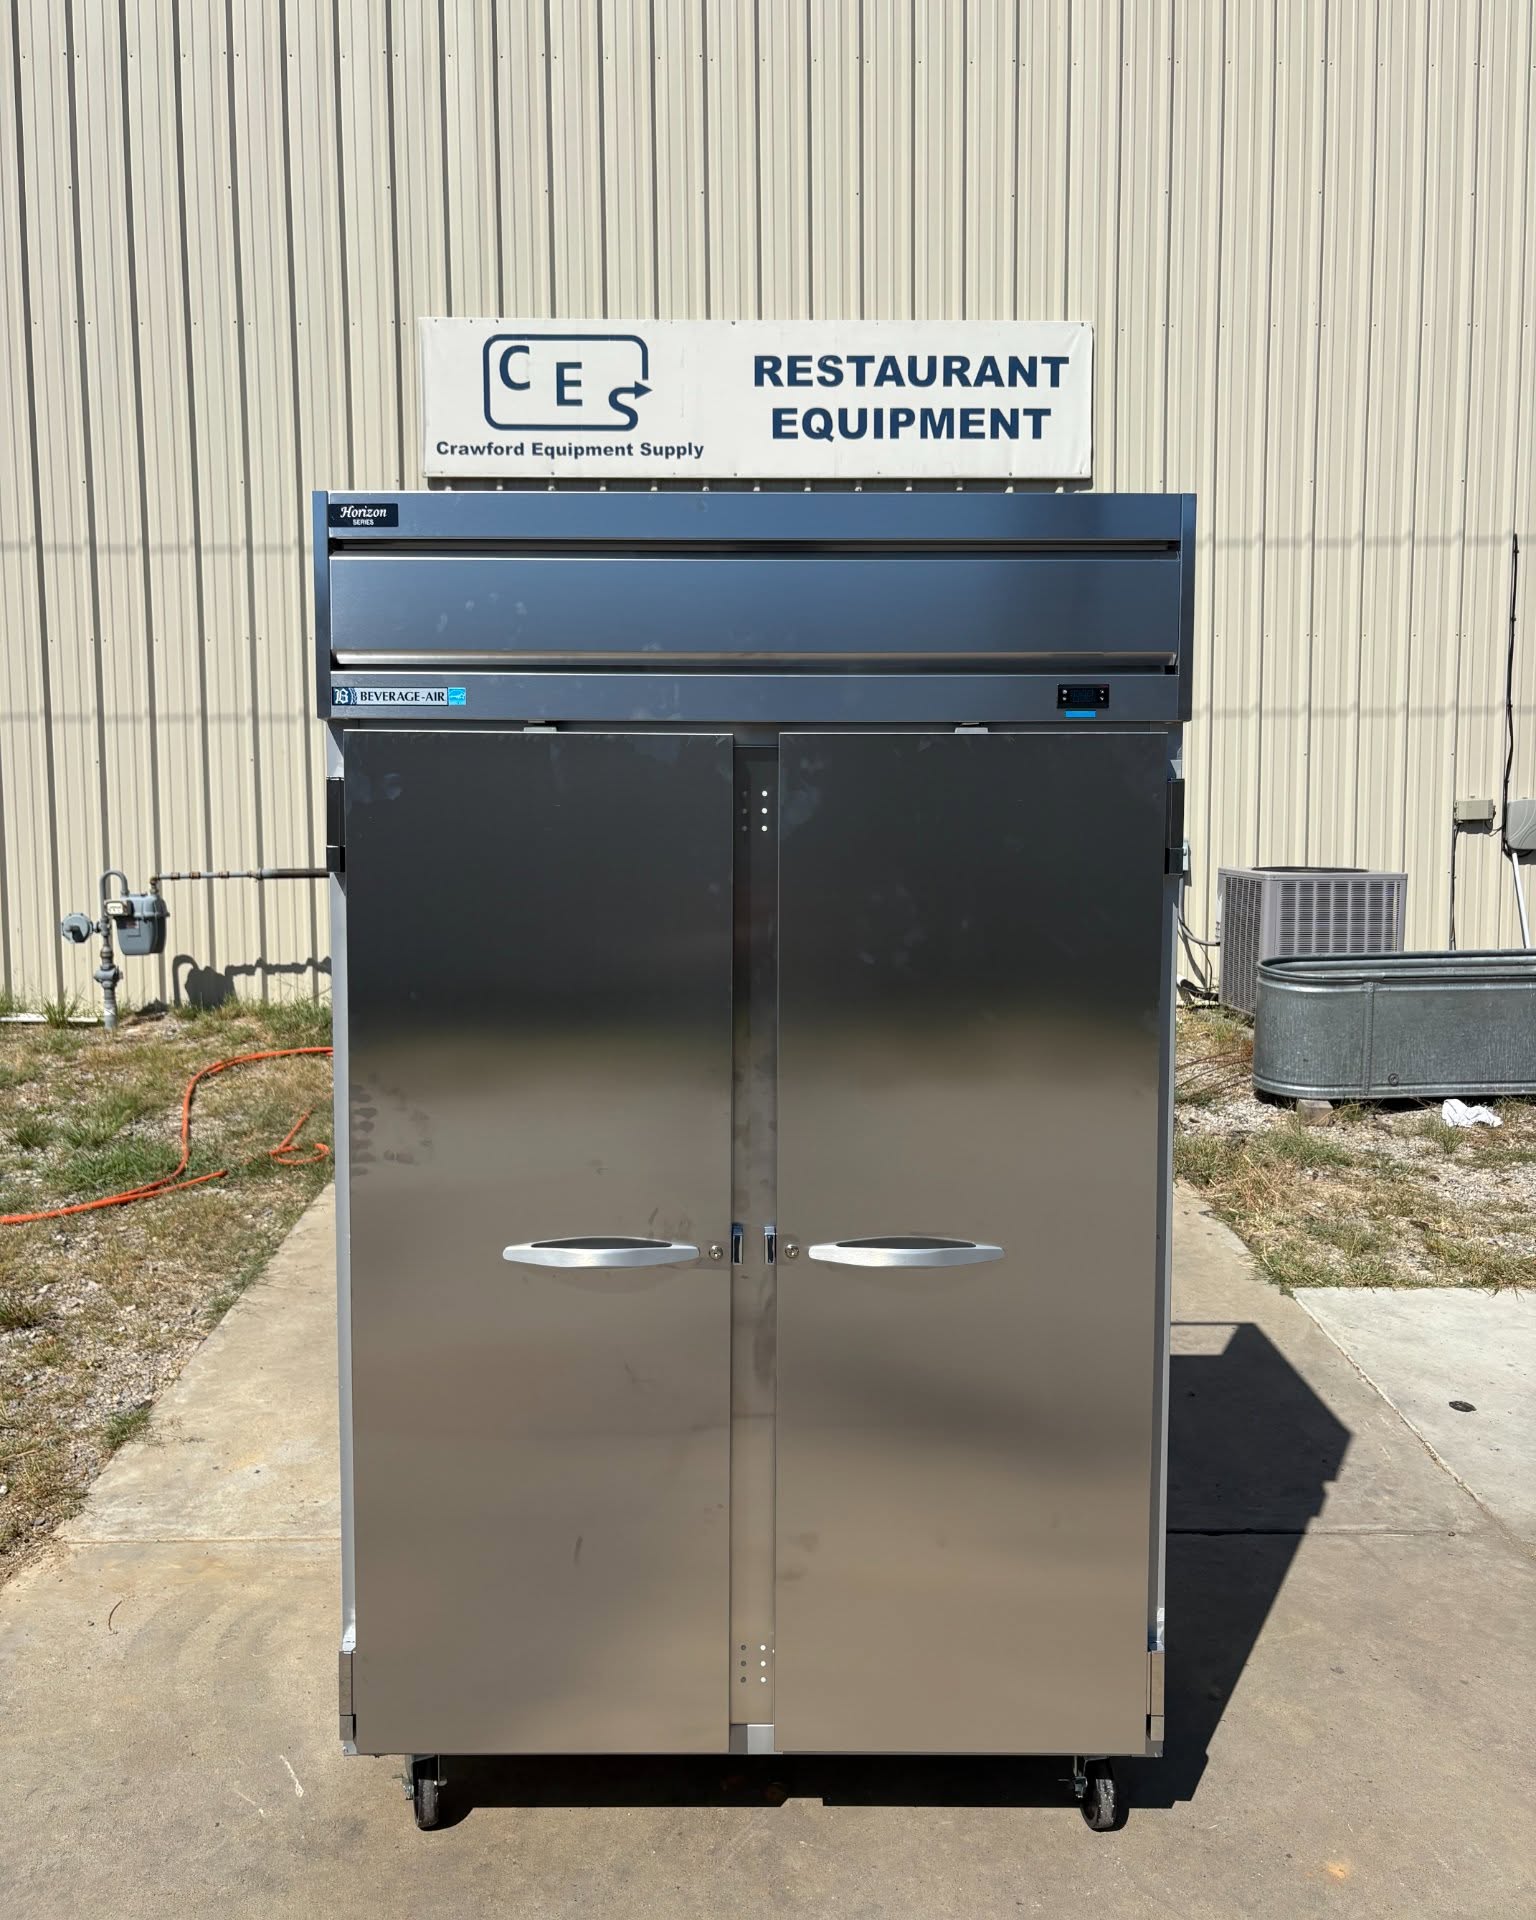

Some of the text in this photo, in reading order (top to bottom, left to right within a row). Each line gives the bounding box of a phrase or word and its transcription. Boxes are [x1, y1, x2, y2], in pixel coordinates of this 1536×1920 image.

[754, 355, 1070, 388] RESTAURANT
[772, 407, 1052, 443] EQUIPMENT
[436, 441, 705, 460] Crawford Equipment Supply
[340, 505, 387, 518] Horizon
[352, 518, 375, 526] SERIES
[360, 691, 445, 702] BEVERAGE-AIR
